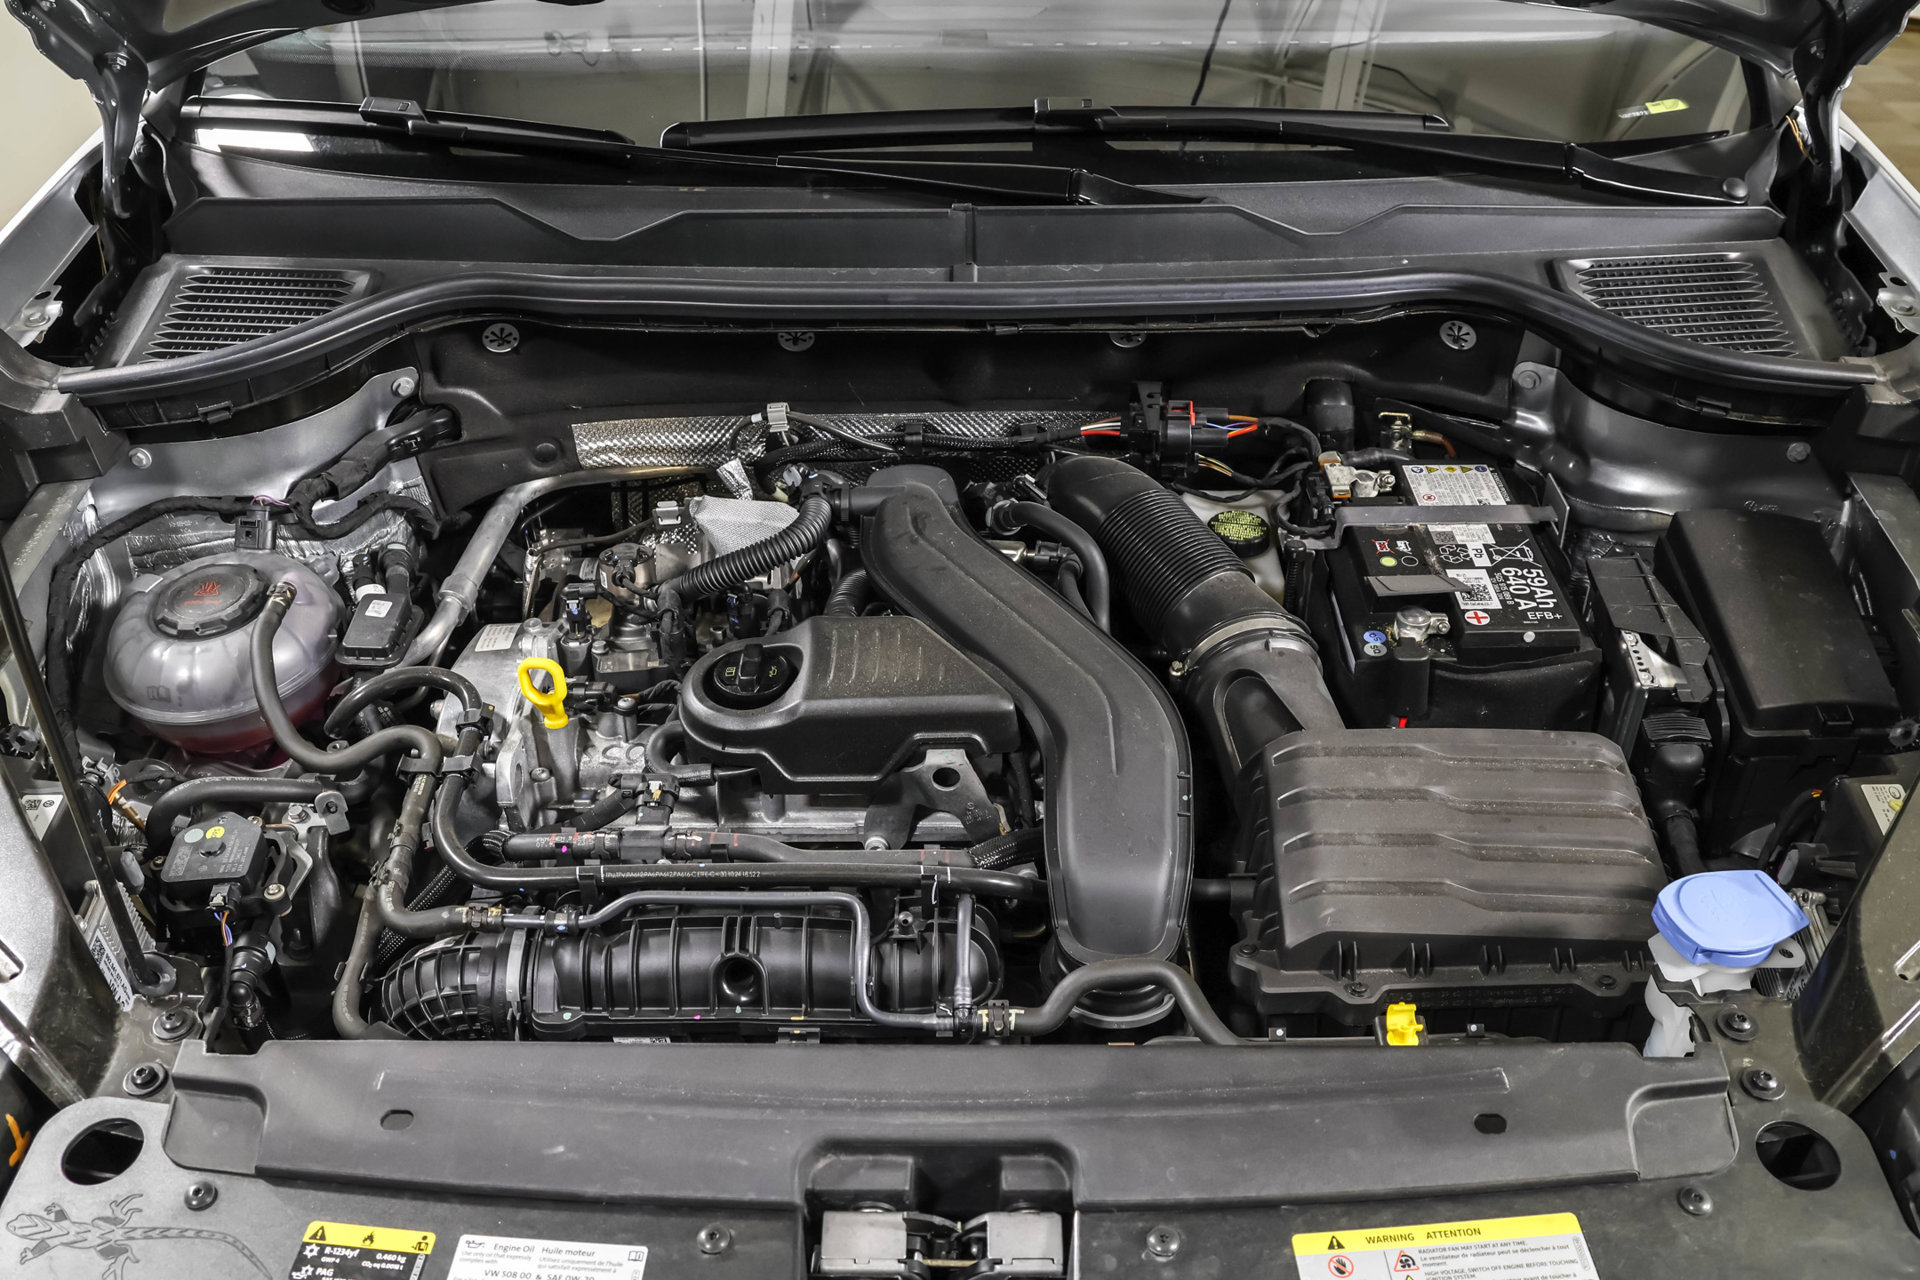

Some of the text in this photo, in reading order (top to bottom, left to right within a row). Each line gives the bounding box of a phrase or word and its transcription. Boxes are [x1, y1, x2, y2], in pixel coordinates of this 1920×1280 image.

[1472, 548, 1484, 559] Pb
[1501, 567, 1530, 595] 640
[1523, 568, 1558, 608] 59Ah
[1514, 598, 1538, 611] A
[1527, 611, 1563, 620] EFB+
[1365, 1233, 1415, 1244] WARNING
[1426, 1227, 1481, 1239] ATTENTION
[494, 1243, 535, 1254] Engine Oil
[541, 1246, 563, 1255] Huile
[323, 1246, 407, 1264] R-1234yf 0.460 kg
[1503, 1262, 1525, 1270] ENGINE
[1549, 1258, 1579, 1266] TOUCHING
[315, 1267, 334, 1277] PAG
[484, 1269, 500, 1277] VW
[502, 1270, 518, 1278] 508
[519, 1271, 532, 1279] 00
